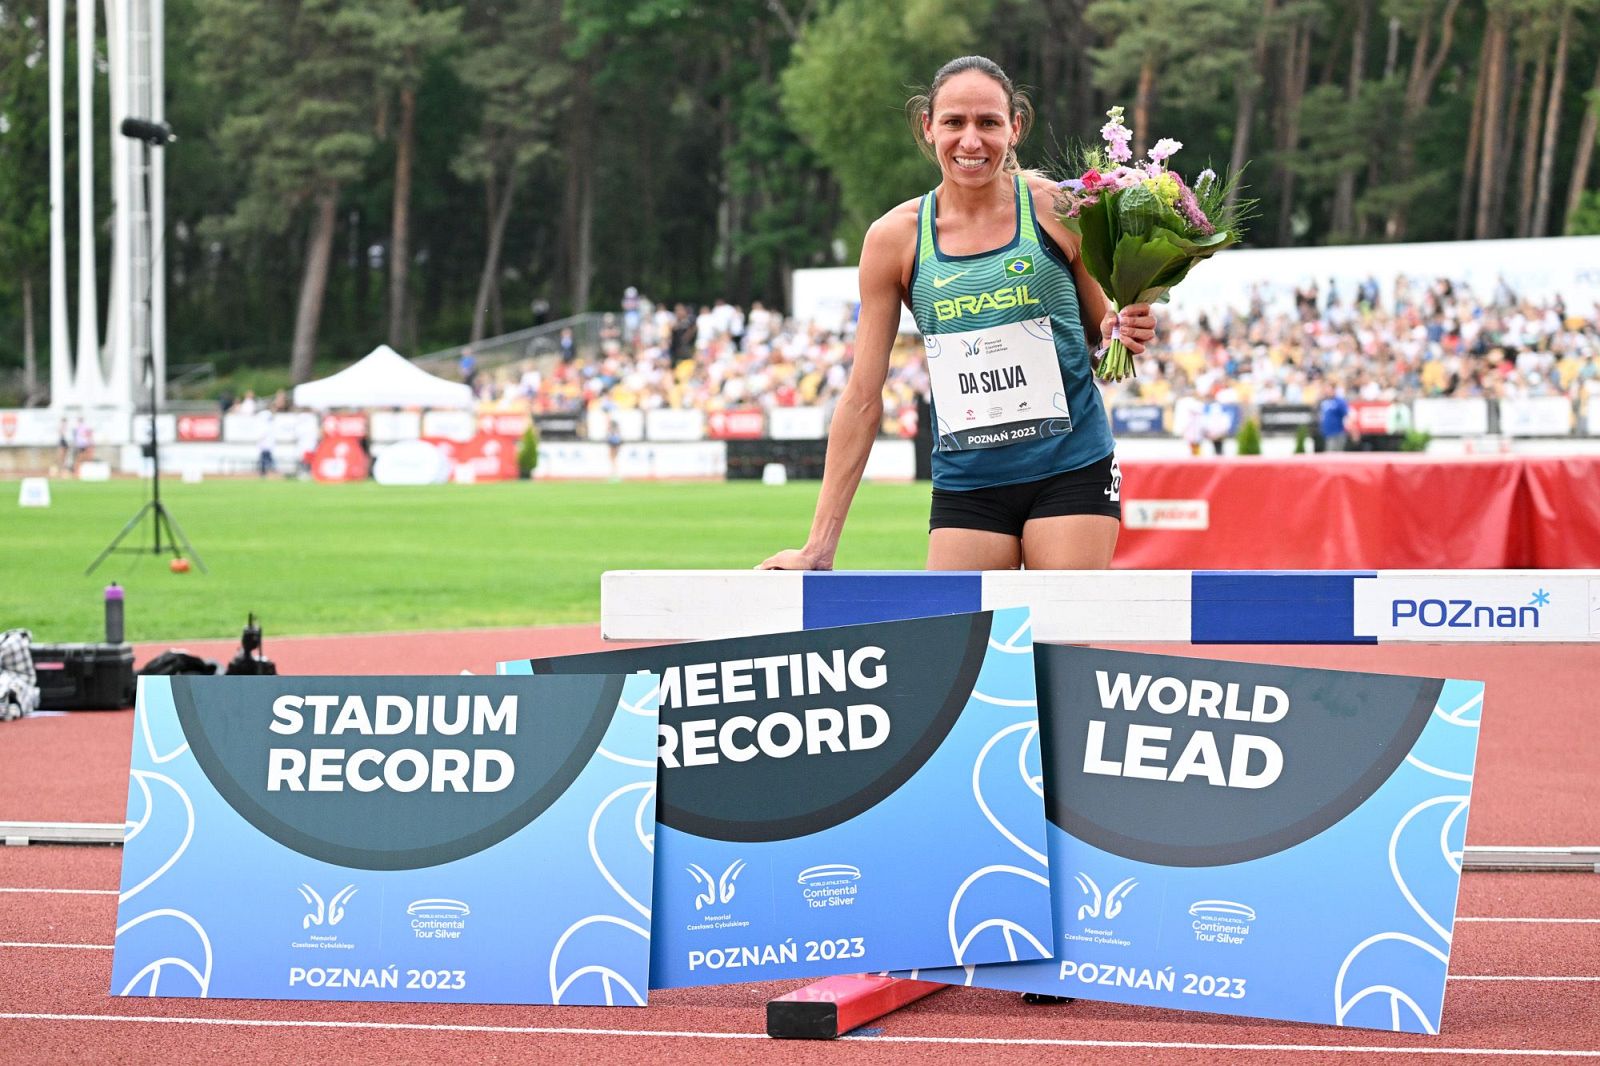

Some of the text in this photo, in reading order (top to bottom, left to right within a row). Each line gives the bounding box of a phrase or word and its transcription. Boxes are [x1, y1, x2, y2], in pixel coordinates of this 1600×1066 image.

[933, 285, 1040, 321] BRASIL
[958, 365, 1027, 394] DA SILVA
[968, 426, 1036, 444] POZNAŃ 2023
[636, 645, 888, 709] MEETING
[1094, 670, 1290, 724] WORLD
[268, 694, 518, 736] STADIUM
[657, 703, 892, 769] RECORD
[1082, 719, 1284, 789] LEAD
[266, 747, 516, 793] RECORD
[803, 884, 858, 898] Continental
[806, 896, 854, 908] Tour Silver
[410, 919, 465, 929] Continental
[414, 929, 462, 938] Tour Silver
[1192, 920, 1250, 935] Continental
[1195, 931, 1245, 945] Tour Silver
[688, 937, 866, 970] POZNAŃ 2023
[289, 964, 466, 990] POZNAŃ 2023
[1059, 960, 1247, 999] POZNAŃ 2023
